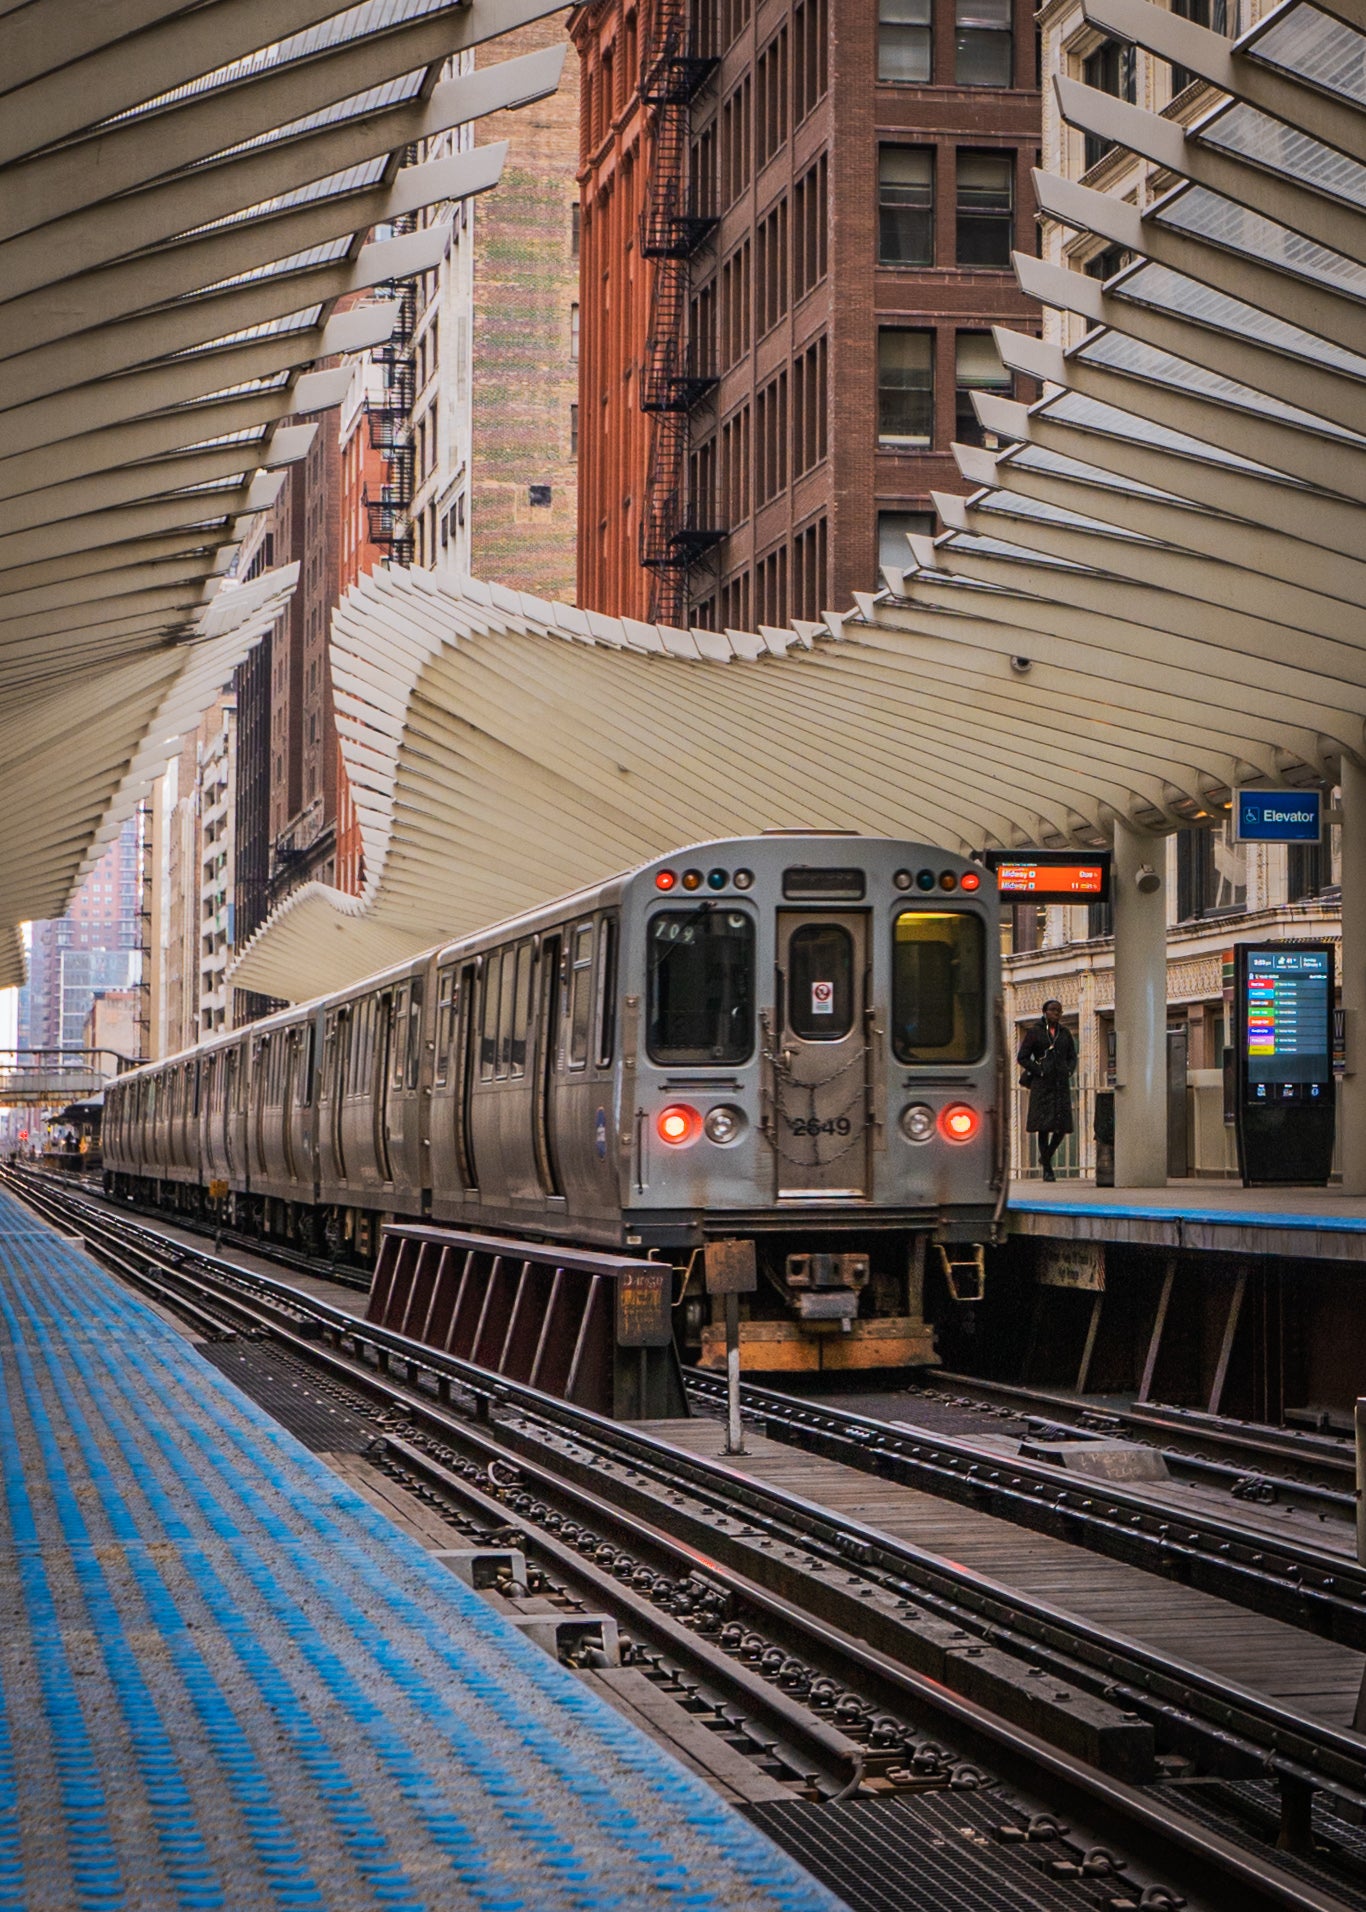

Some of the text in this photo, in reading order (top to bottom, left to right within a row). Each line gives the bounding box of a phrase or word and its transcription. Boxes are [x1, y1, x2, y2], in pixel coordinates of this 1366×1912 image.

[1263, 808, 1315, 823] Elevator
[655, 921, 695, 942] 709
[792, 1117, 852, 1136] 2649
